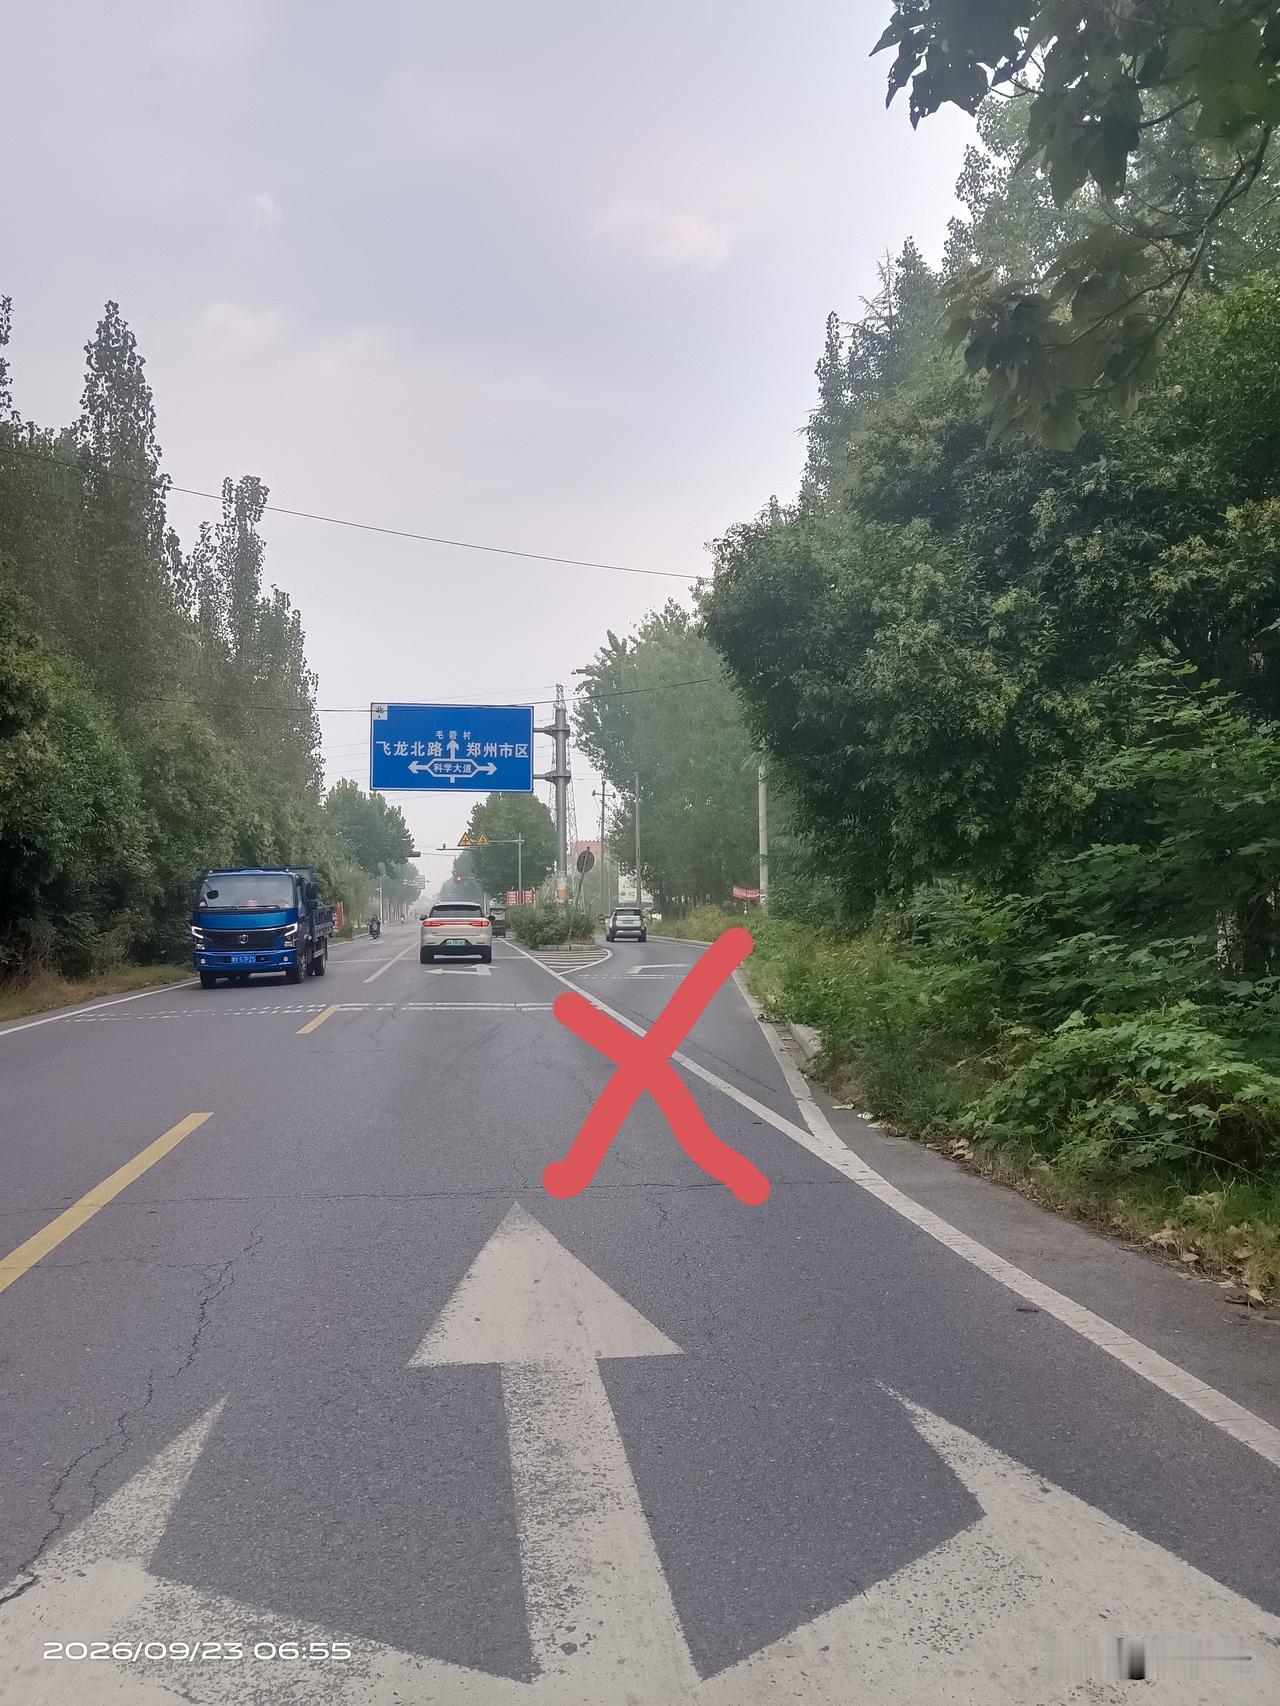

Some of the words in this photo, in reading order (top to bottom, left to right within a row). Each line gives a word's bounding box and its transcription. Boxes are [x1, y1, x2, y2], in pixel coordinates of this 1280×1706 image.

[375, 706, 384, 714] 北
[376, 741, 443, 757] 飞龙北路
[466, 742, 529, 758] 郑州市区
[433, 763, 473, 773] 科学大道
